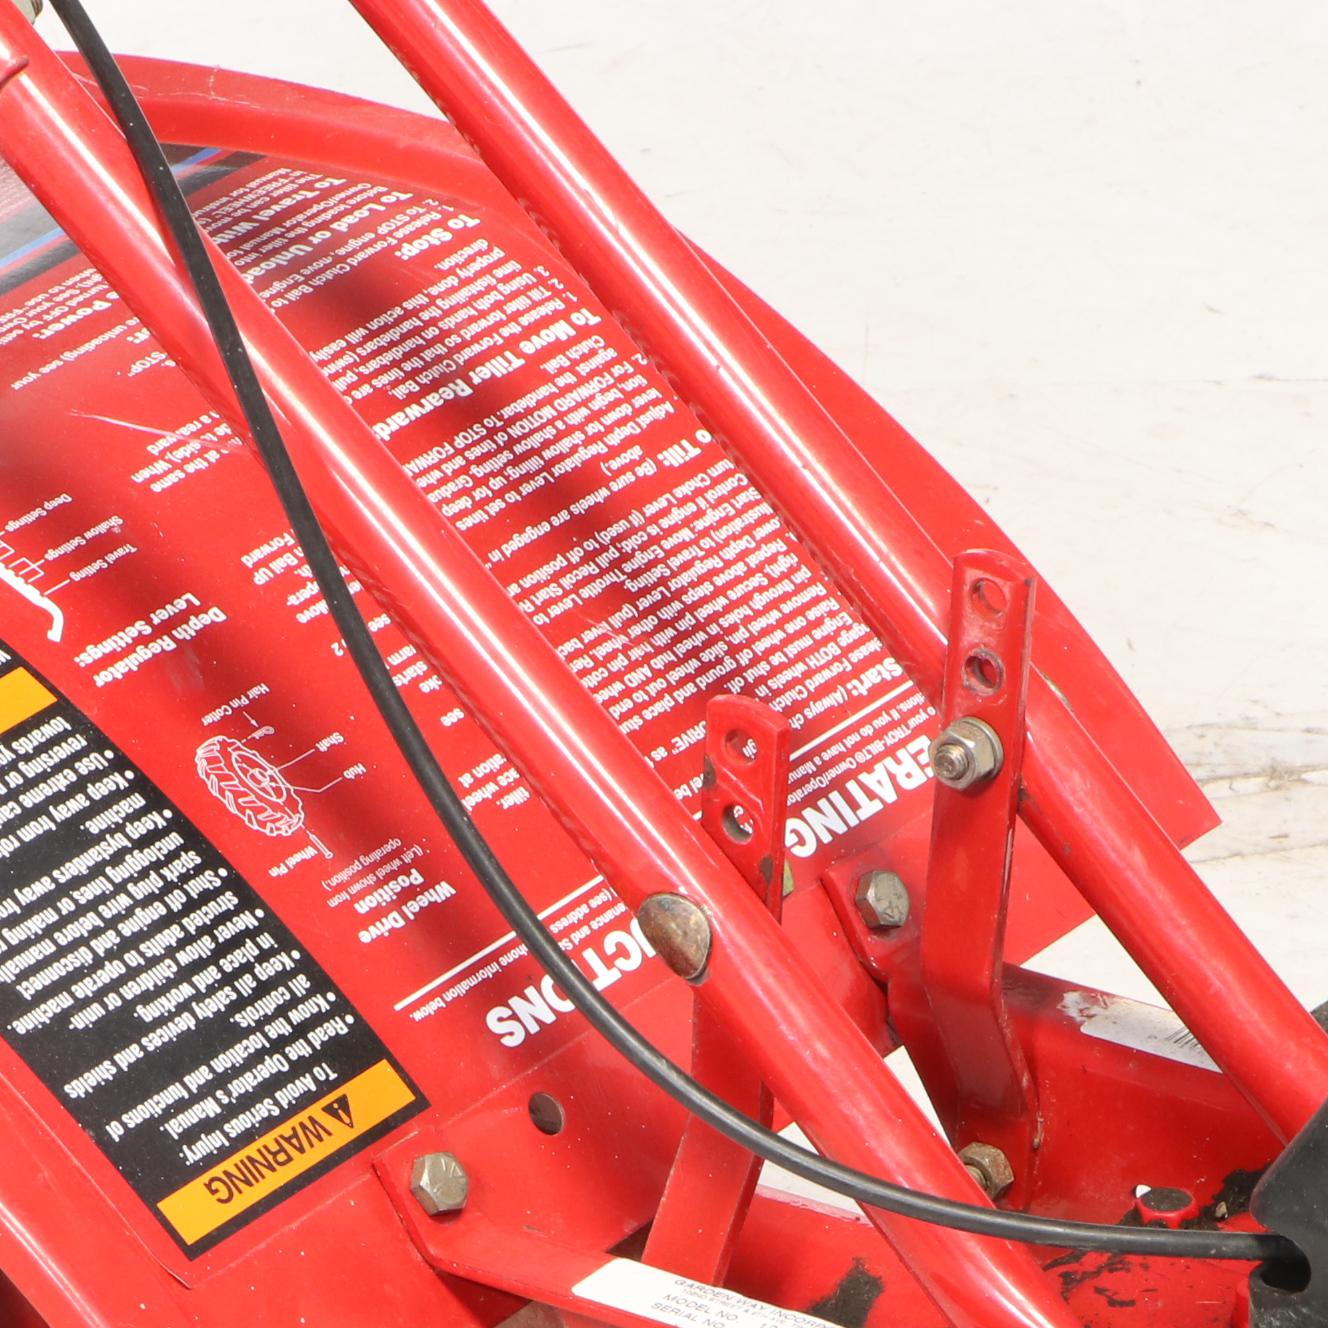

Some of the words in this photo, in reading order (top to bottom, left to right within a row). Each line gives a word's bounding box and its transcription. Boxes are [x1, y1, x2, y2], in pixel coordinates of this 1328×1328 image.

[380, 191, 413, 203] To
[330, 203, 386, 232] Load
[447, 214, 480, 229] To
[308, 231, 332, 244] or
[395, 228, 453, 260] Stop:
[518, 297, 565, 326] Release
[570, 308, 601, 325] To
[499, 322, 522, 337] the
[519, 320, 576, 354] Move
[453, 333, 504, 365] Forward
[415, 359, 457, 384] Clutch
[469, 350, 525, 385] Tiller
[388, 380, 420, 400] Bail.
[657, 439, 702, 467] Till:
[634, 457, 657, 477] (Be
[609, 471, 636, 491] sure
[44, 493, 72, 515] Deep
[570, 487, 611, 514] wheels
[5, 508, 47, 532] Settings
[84, 516, 123, 539] Shallow
[550, 510, 570, 526] are
[44, 536, 86, 561] Settings
[501, 521, 551, 558] engaged
[104, 544, 137, 564] Travel
[488, 549, 505, 562] in
[69, 559, 108, 581] Setting
[150, 593, 201, 625] Lever
[172, 606, 227, 640] Depth
[811, 611, 853, 640] Engine
[74, 621, 152, 667] Settings:
[783, 635, 814, 658] must
[93, 635, 177, 687] Regulator
[743, 661, 771, 683] shut
[769, 651, 788, 666] be
[724, 677, 745, 695] off.
[846, 657, 903, 696] Start:
[229, 695, 249, 708] Pin
[247, 683, 270, 699] Hair
[201, 705, 232, 726] Cotter
[315, 732, 344, 752] Shaft
[343, 763, 367, 779] Hub
[285, 846, 318, 869] Wheel
[359, 838, 401, 866] operating
[400, 844, 423, 863] (Left
[268, 863, 288, 877] Pin
[321, 860, 362, 891] position.)
[375, 858, 403, 880] wheel
[347, 873, 377, 895] shown
[354, 868, 424, 914] Position
[327, 891, 351, 907] from
[401, 881, 456, 920] Wheel
[213, 910, 259, 943] Never
[358, 911, 405, 943] Drive
[175, 935, 216, 966] allow
[256, 932, 278, 949] in
[219, 938, 260, 973] place
[254, 952, 295, 981] Keep
[119, 958, 178, 1000] children
[191, 965, 222, 993] and
[234, 973, 257, 997] all
[288, 974, 311, 997] all
[442, 961, 502, 1002] information
[69, 1002, 106, 1029] unin-
[103, 993, 122, 1011] or
[133, 982, 196, 1022] working.
[191, 986, 237, 1020] safety
[230, 986, 291, 1027] controls.
[288, 994, 330, 1025] Know
[409, 997, 446, 1021] below.
[141, 1012, 196, 1051] devices
[264, 1017, 293, 1039] the
[307, 1016, 349, 1050] Read
[113, 1043, 144, 1071] and
[210, 1032, 270, 1073] location
[285, 1039, 313, 1060] the
[64, 1060, 117, 1098] shields
[183, 1065, 213, 1093] and
[215, 1054, 289, 1104] Operator's
[313, 1062, 338, 1081] To
[274, 1073, 317, 1109] Avoid
[121, 1082, 189, 1128] functions
[160, 1096, 222, 1140] Manual.
[223, 1098, 280, 1138] Serious
[105, 1121, 124, 1142] of
[179, 1130, 230, 1166] Injury:
[203, 1115, 333, 1204] WARNING
[661, 1291, 715, 1315] MODEL
[671, 1276, 737, 1302] GARDEN
[733, 1296, 769, 1312] WAY
[648, 1300, 702, 1322] SERIAL
